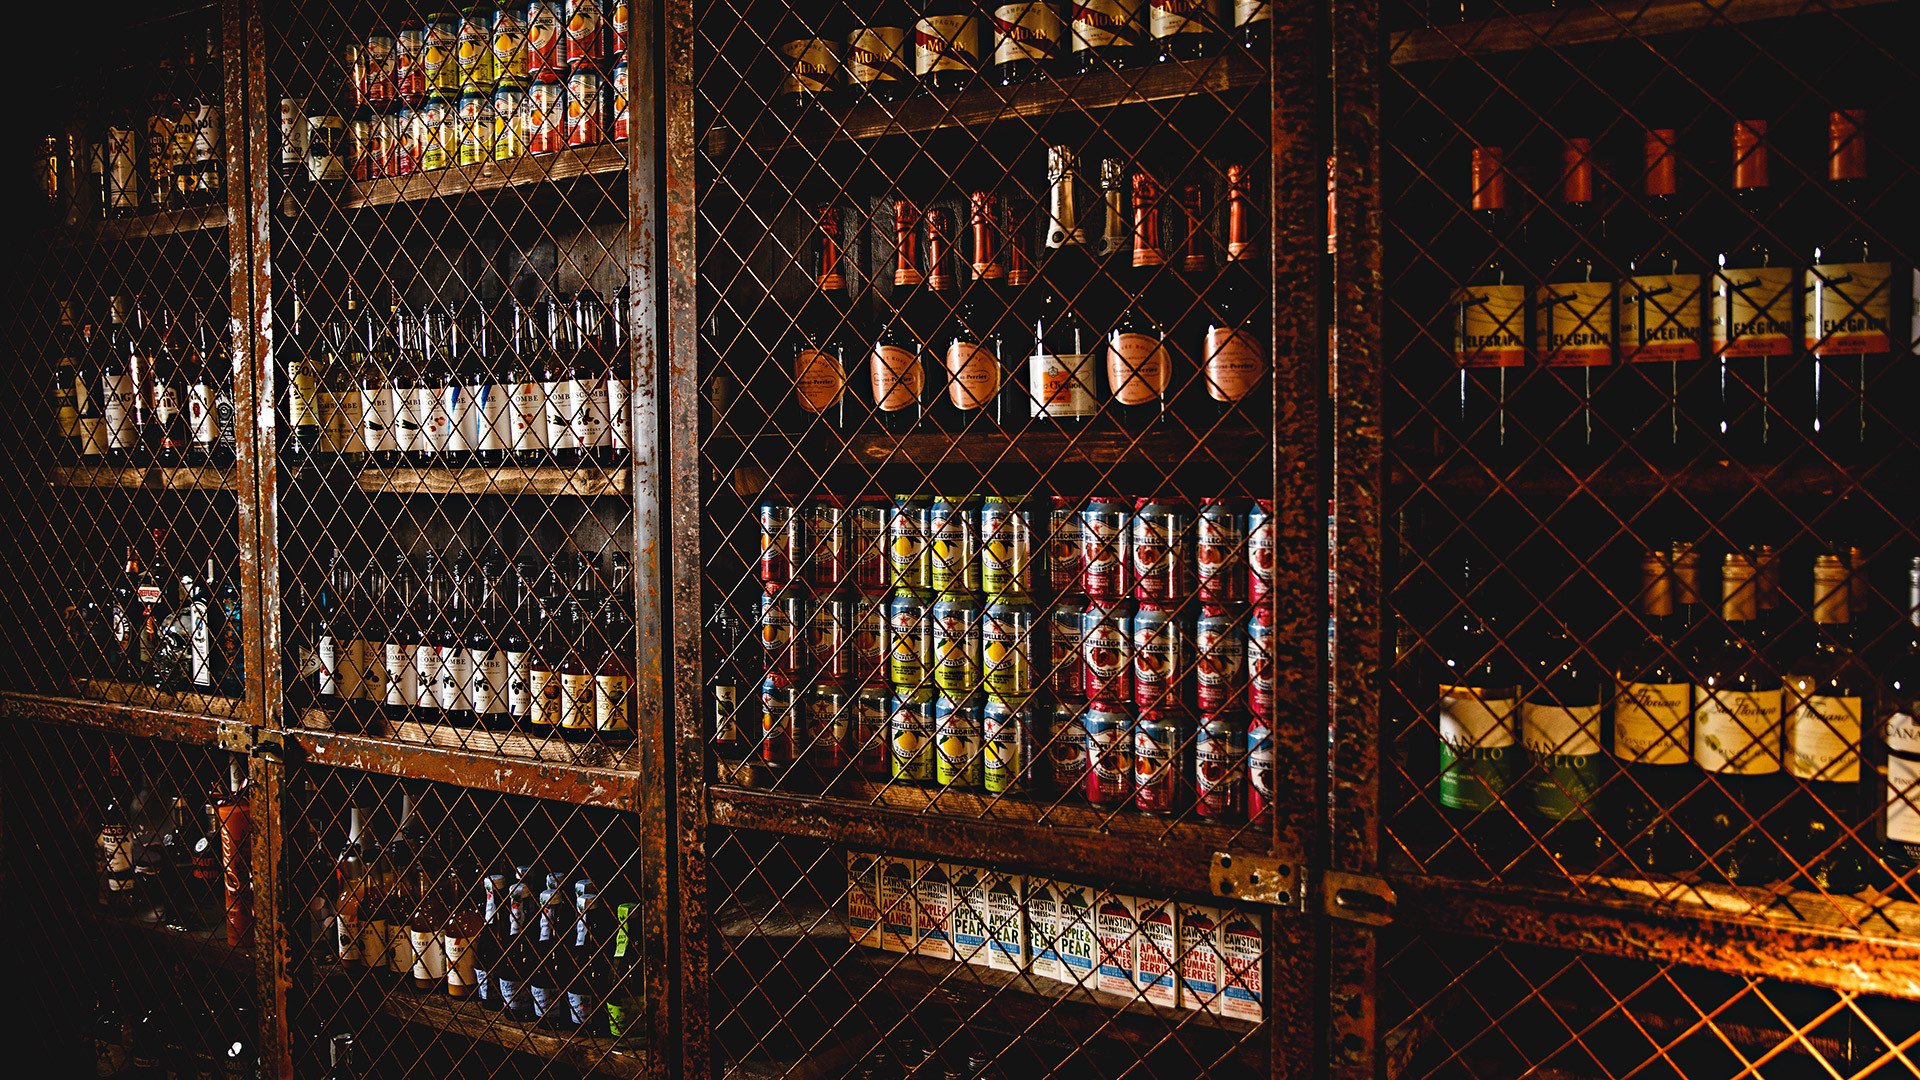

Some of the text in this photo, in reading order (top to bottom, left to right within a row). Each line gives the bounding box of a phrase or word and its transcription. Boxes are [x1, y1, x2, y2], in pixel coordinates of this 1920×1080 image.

[926, 38, 966, 52] MUM
[954, 886, 983, 900] CAWTON
[988, 893, 1018, 907] CAWSTO
[955, 907, 977, 920] APPL
[1028, 900, 1056, 913] AWSTON
[1061, 905, 1091, 920] CAWTON
[884, 912, 912, 926] ANGO
[918, 915, 948, 931] MAGO
[1098, 915, 1132, 929] CAWSTON
[955, 919, 984, 938] PEAR
[1143, 922, 1173, 937] AWSTON
[1181, 926, 1217, 943] CAWON
[1030, 934, 1055, 949] PEA
[1061, 938, 1091, 959] PEAR
[1140, 943, 1164, 955] APPE
[1223, 933, 1260, 950] CAWSTON
[1099, 947, 1132, 960] SUMER
[1140, 952, 1172, 967] SUMMR
[1099, 955, 1132, 969] BERIES
[1140, 962, 1173, 977] BERRIS
[1181, 958, 1216, 973] SUMMER
[1225, 957, 1251, 969] APPL
[1181, 968, 1217, 983] BERRIES
[1224, 966, 1260, 981] SUMER
[1224, 976, 1260, 991] BERIES
